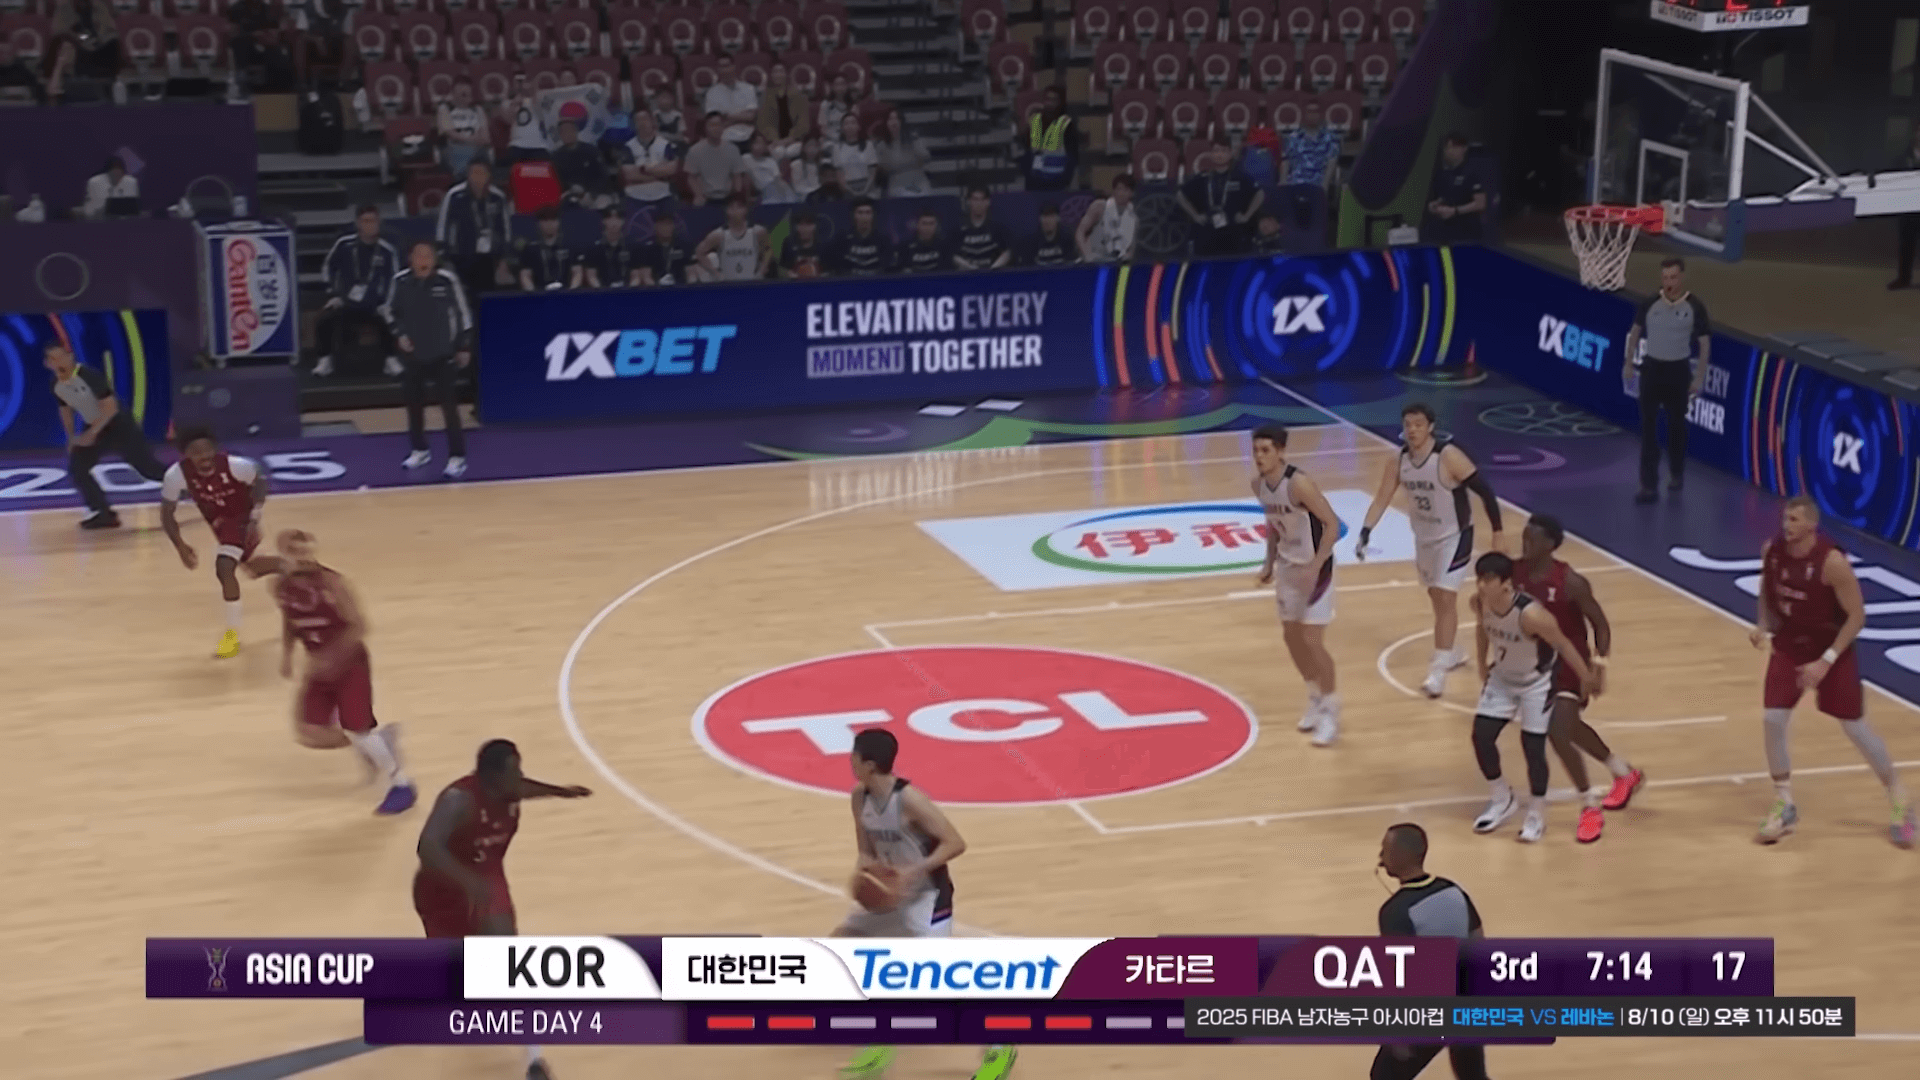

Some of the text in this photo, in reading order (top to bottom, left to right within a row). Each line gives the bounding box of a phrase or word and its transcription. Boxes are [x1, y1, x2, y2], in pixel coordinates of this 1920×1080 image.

[1741, 8, 1796, 23] TISSOT
[807, 290, 1049, 339] ELEVATING EVERY
[1272, 293, 1329, 336] 1X
[544, 324, 738, 382] 1XBET
[812, 334, 1043, 374] MOMENT TOGETHER
[1538, 314, 1611, 372] 1XBET
[1832, 431, 1865, 475] 1X
[741, 689, 1209, 756] TCL
